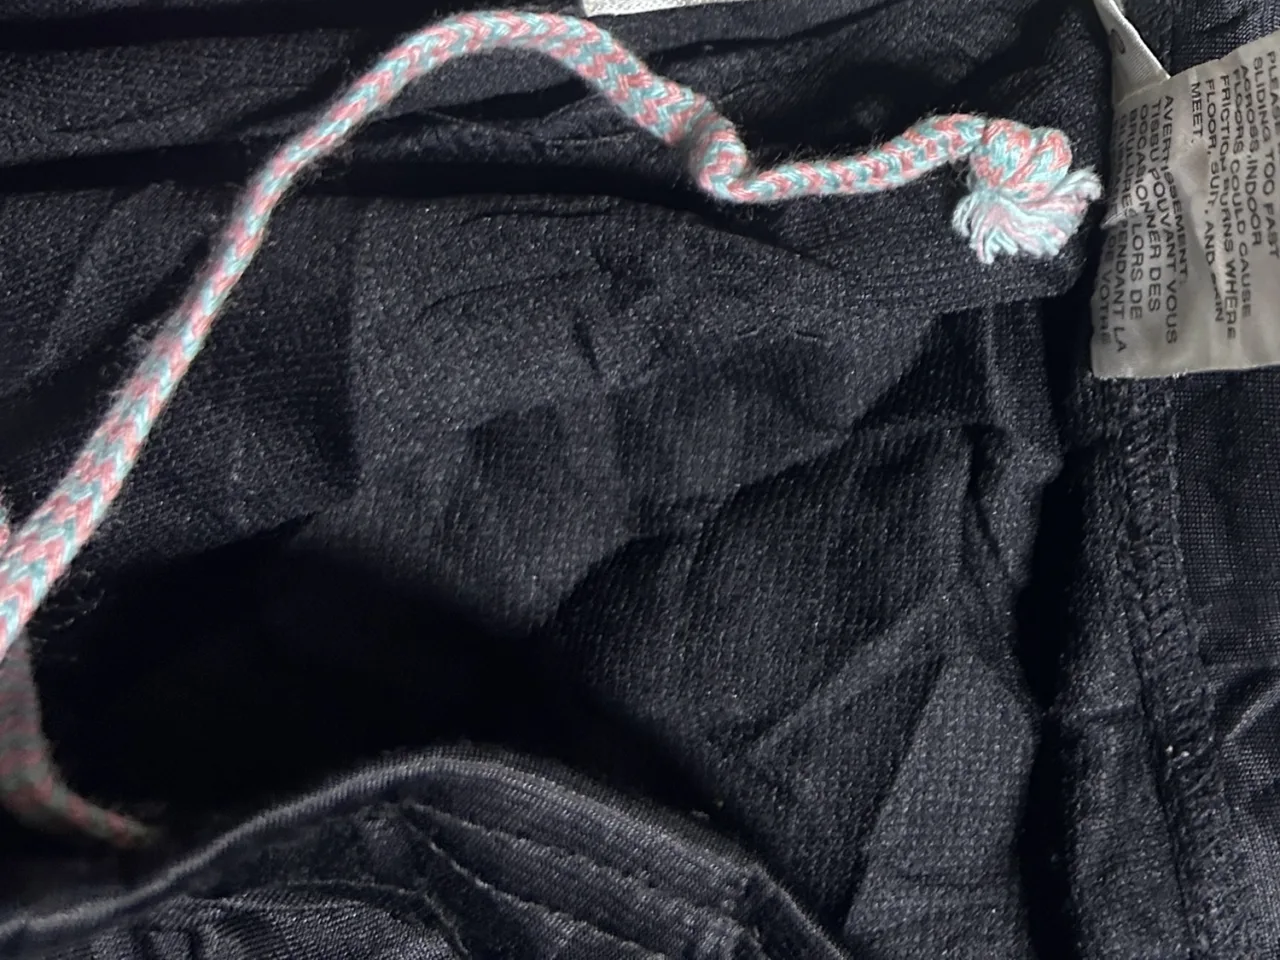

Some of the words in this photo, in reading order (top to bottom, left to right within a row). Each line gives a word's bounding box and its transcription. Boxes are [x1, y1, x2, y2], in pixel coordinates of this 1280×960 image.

[1150, 98, 1161, 162] TISSU
[1190, 82, 1203, 143] MEET.
[1233, 68, 1245, 154] FLOORS
[1240, 65, 1259, 152] ACROSS
[1254, 57, 1270, 142] SLIDING
[1135, 104, 1161, 259] OCCASIONNER
[1148, 267, 1161, 312] DES
[1230, 160, 1246, 234] COULD
[1245, 159, 1262, 246] INDOOR
[1263, 148, 1276, 195] TOO
[1130, 223, 1144, 282] LORS
[1148, 167, 1176, 272] POUVANT
[1204, 221, 1216, 265] AND
[1263, 202, 1280, 259] FAST
[1113, 220, 1128, 319] PENDANT
[1129, 289, 1142, 320] DE
[1224, 258, 1238, 340] WHERE
[1238, 242, 1251, 318] CAUSE
[1114, 326, 1127, 354] LA
[1166, 278, 1178, 344] VOUS
